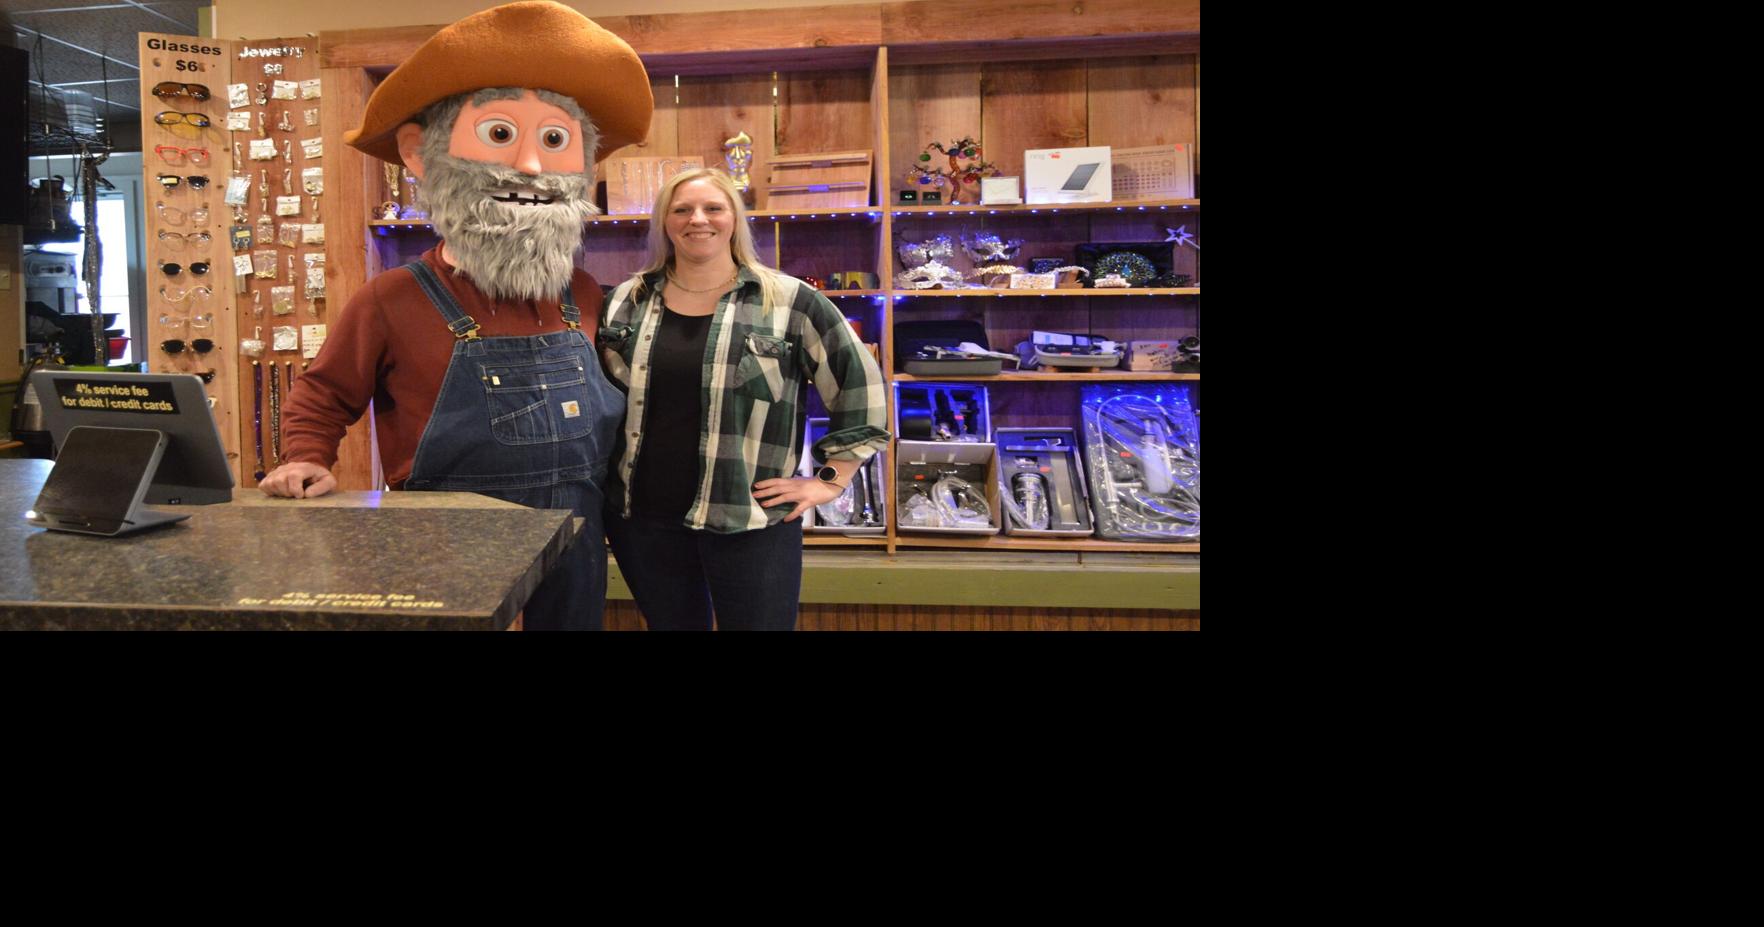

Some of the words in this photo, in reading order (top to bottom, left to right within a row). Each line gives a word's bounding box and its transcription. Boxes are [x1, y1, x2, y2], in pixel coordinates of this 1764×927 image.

[147, 38, 222, 56] Glasses
[175, 59, 198, 72] $6
[75, 383, 92, 394] 4%
[93, 385, 130, 395] service
[131, 385, 149, 396] fee
[61, 396, 77, 406] for
[78, 397, 105, 408] debit
[110, 398, 142, 409] credit
[142, 401, 174, 411] cards
[268, 598, 318, 606] debit
[390, 600, 444, 608] cards
